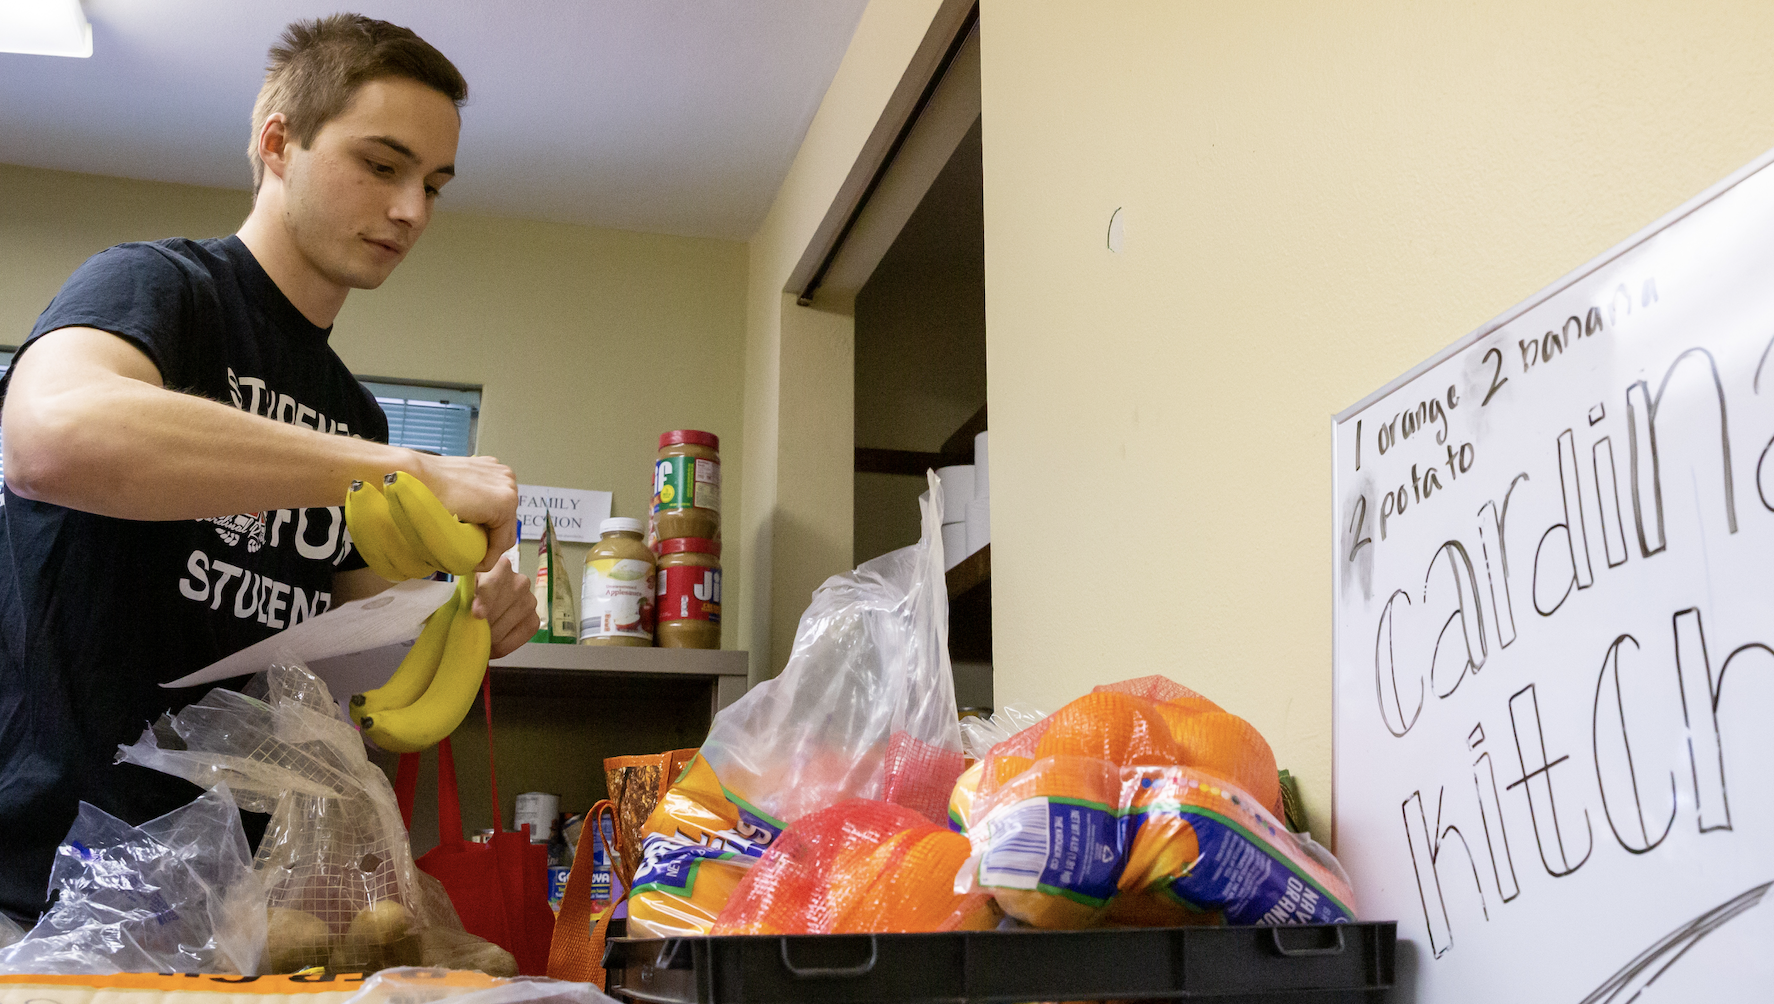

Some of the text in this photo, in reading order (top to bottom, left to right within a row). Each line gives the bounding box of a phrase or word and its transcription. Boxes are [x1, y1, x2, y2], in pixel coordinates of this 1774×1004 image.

[1377, 384, 1460, 446] orange
[1481, 347, 1508, 407] 2
[1518, 277, 1660, 373] banana
[227, 366, 362, 439] STUDEN
[517, 514, 582, 528] ECION
[518, 495, 581, 510] FAMILY
[1349, 442, 1475, 562] 2 potato
